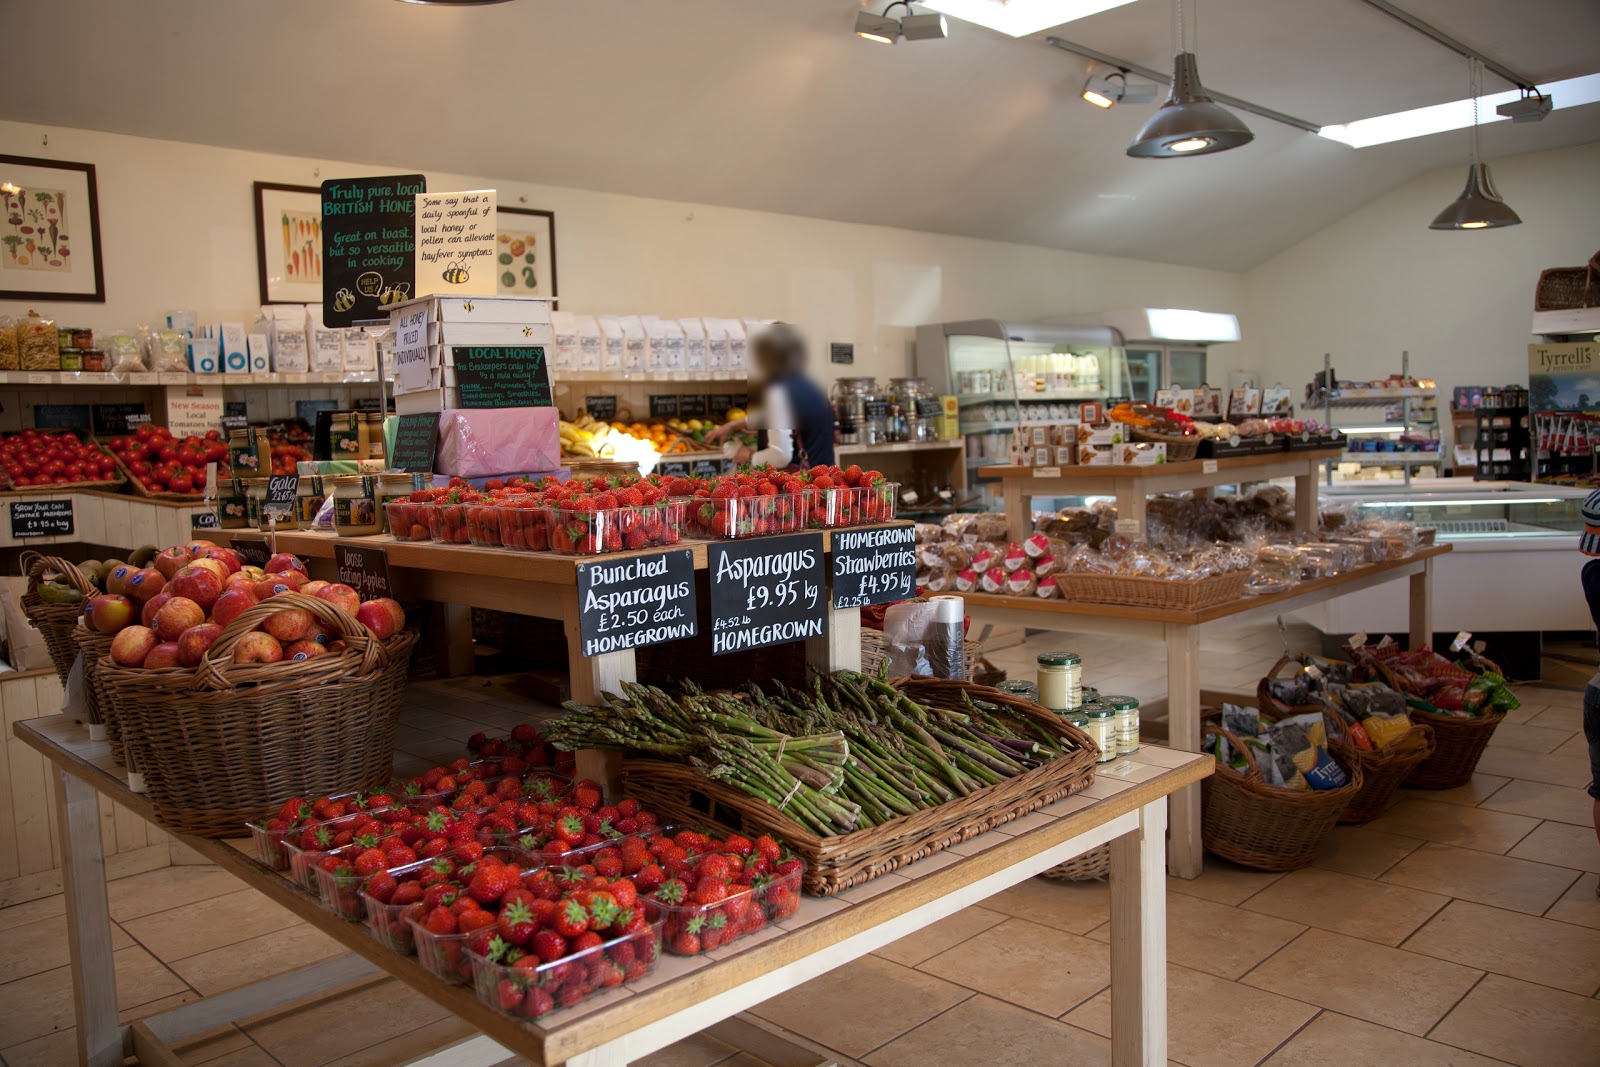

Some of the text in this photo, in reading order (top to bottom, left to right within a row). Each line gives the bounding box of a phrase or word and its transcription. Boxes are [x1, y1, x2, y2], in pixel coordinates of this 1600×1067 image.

[329, 181, 425, 201] Truly pure, local
[323, 201, 373, 216] BRITISH
[422, 198, 441, 209] Some
[445, 198, 459, 208] say
[462, 195, 479, 203] that
[421, 206, 491, 222] daily spoonful of
[333, 227, 413, 247] Great on toast,
[421, 223, 437, 234] local
[441, 223, 465, 235] honey
[421, 232, 495, 247] pollen can alleviate
[329, 241, 415, 257] but so versatile
[421, 248, 455, 263] hayfever
[347, 255, 404, 271] in cooking
[400, 311, 426, 329] ALL HONEY
[403, 330, 419, 346] PRICED
[396, 346, 427, 366] INDIVIDUALLY
[468, 348, 544, 364] LOCAL HONEY
[456, 363, 467, 371] The
[508, 363, 524, 373] only
[191, 402, 219, 410] Season
[170, 420, 206, 428] Tomatoes
[270, 476, 297, 493] Gala
[15, 504, 33, 512] GROW
[34, 503, 49, 512] YOUR
[56, 520, 69, 530] bag
[840, 527, 915, 551] HOMEGROWN
[716, 549, 815, 588] Asparagus
[835, 547, 916, 576] Strawberries
[590, 555, 669, 587] Bunched
[340, 567, 386, 592] Eating Apples
[858, 571, 911, 596] £4.95 kg
[584, 581, 690, 614] Asparagus
[746, 580, 818, 611] £9.95 kg
[837, 596, 870, 609] £2.25 lb
[597, 605, 685, 632] £2.50 each
[713, 615, 751, 631] £4.52 lb
[587, 622, 694, 656] HOMEGROWN
[714, 618, 822, 653] HOMEGROWN
